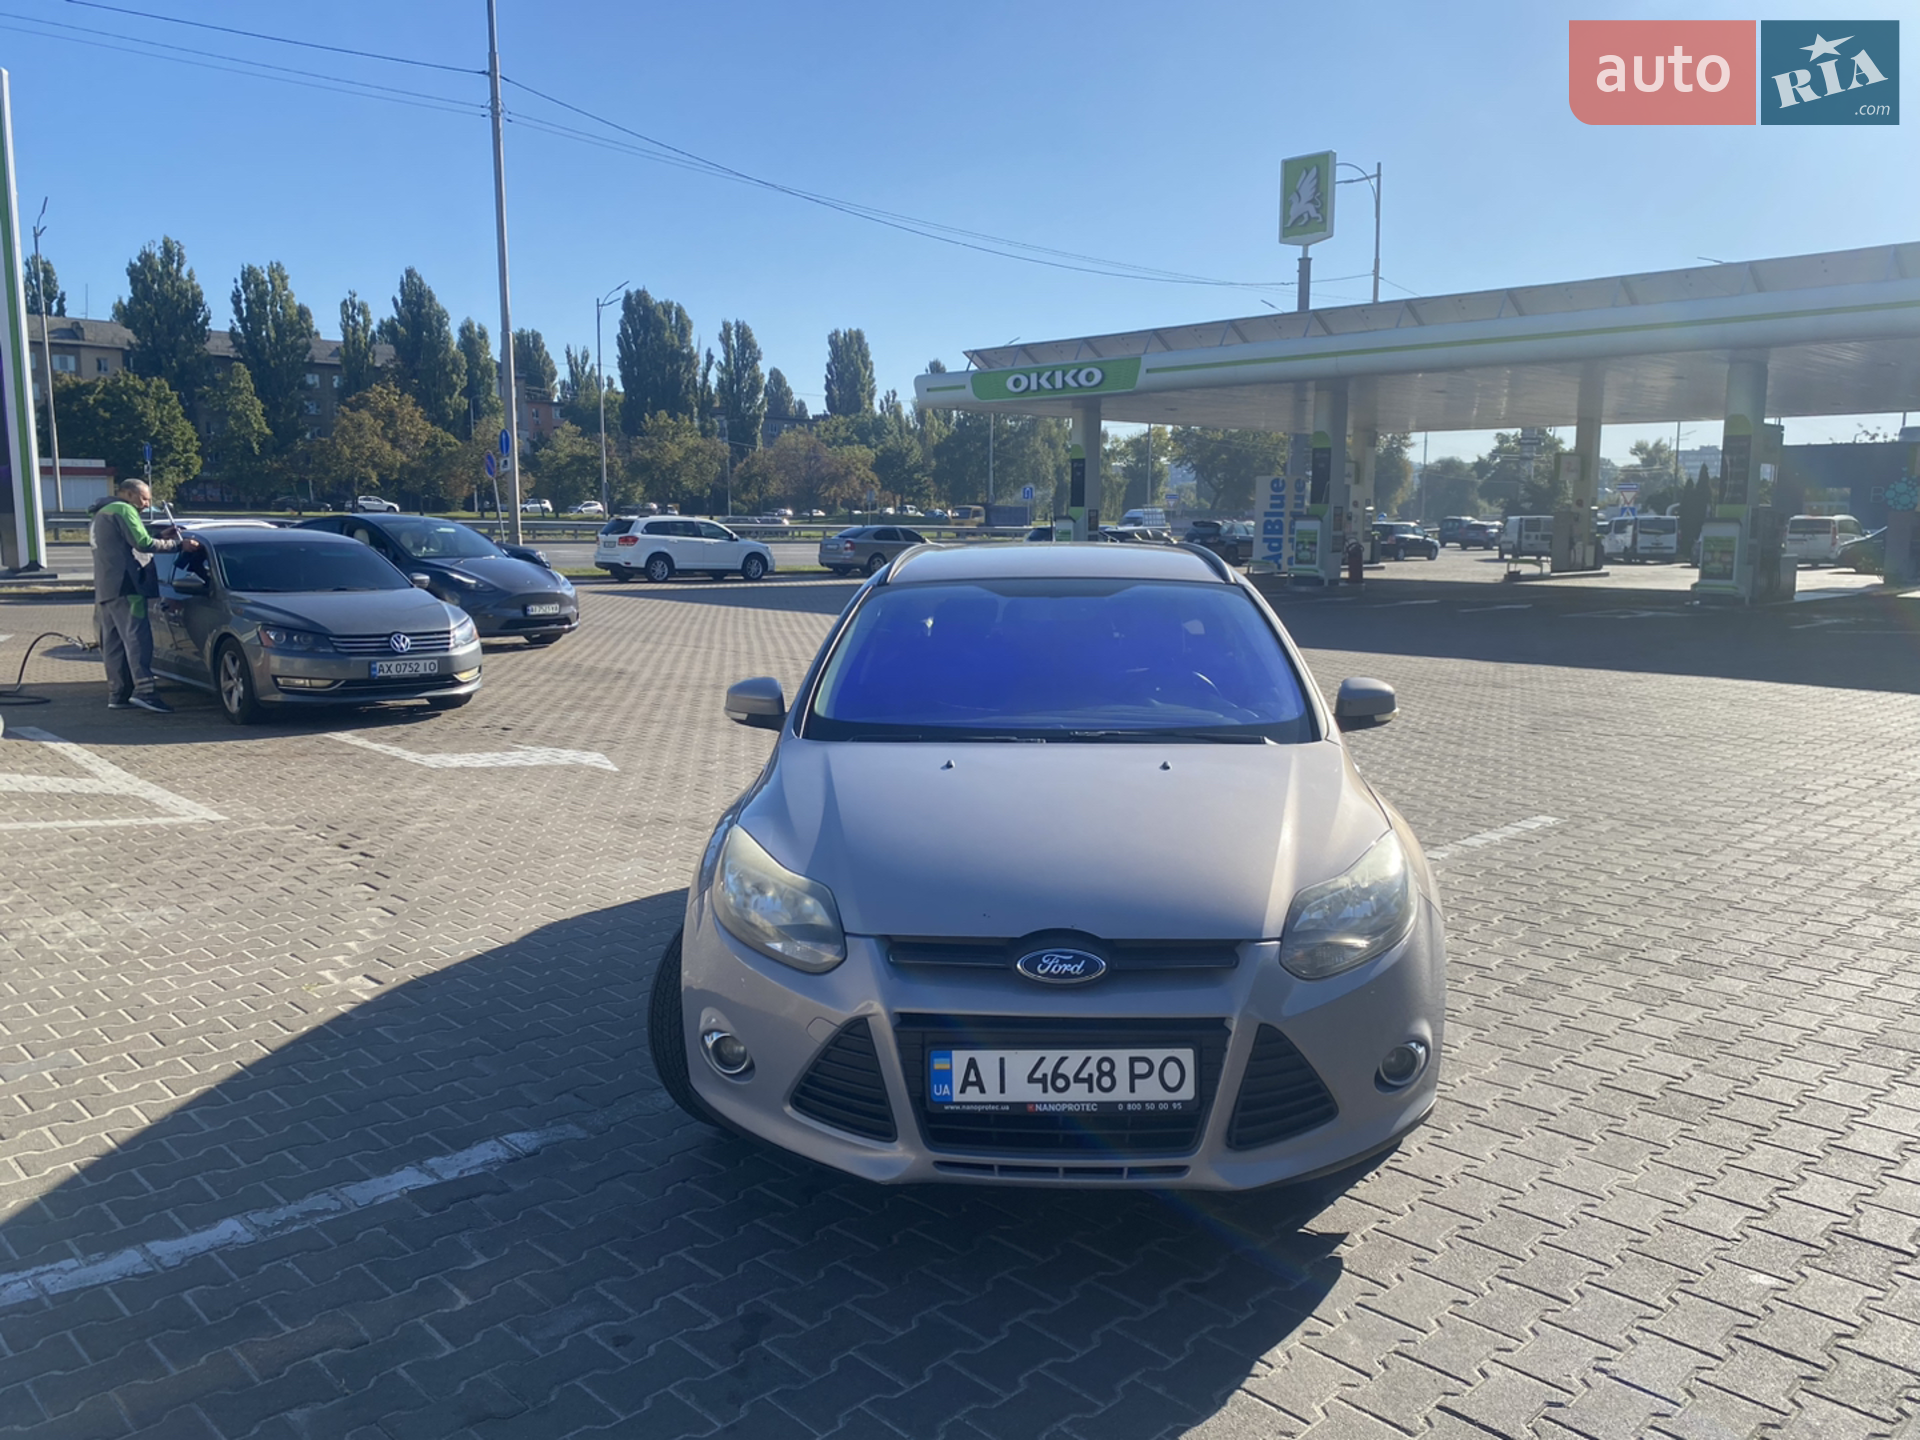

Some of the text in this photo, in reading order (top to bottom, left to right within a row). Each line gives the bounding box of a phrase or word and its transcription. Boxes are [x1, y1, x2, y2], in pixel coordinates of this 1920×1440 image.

[1005, 367, 1102, 393] OKKO
[1262, 477, 1287, 570] AdBlue
[378, 661, 437, 674] AX 0752 IO
[1037, 954, 1085, 975] Ford
[959, 1056, 1187, 1095] AI 4648 PO
[933, 1084, 950, 1096] UA
[944, 1103, 1010, 1112] www.nanoprotec.ua
[1035, 1103, 1098, 1112] NANOPROTEC
[1117, 1103, 1182, 1111] 0 800 50 00 95
